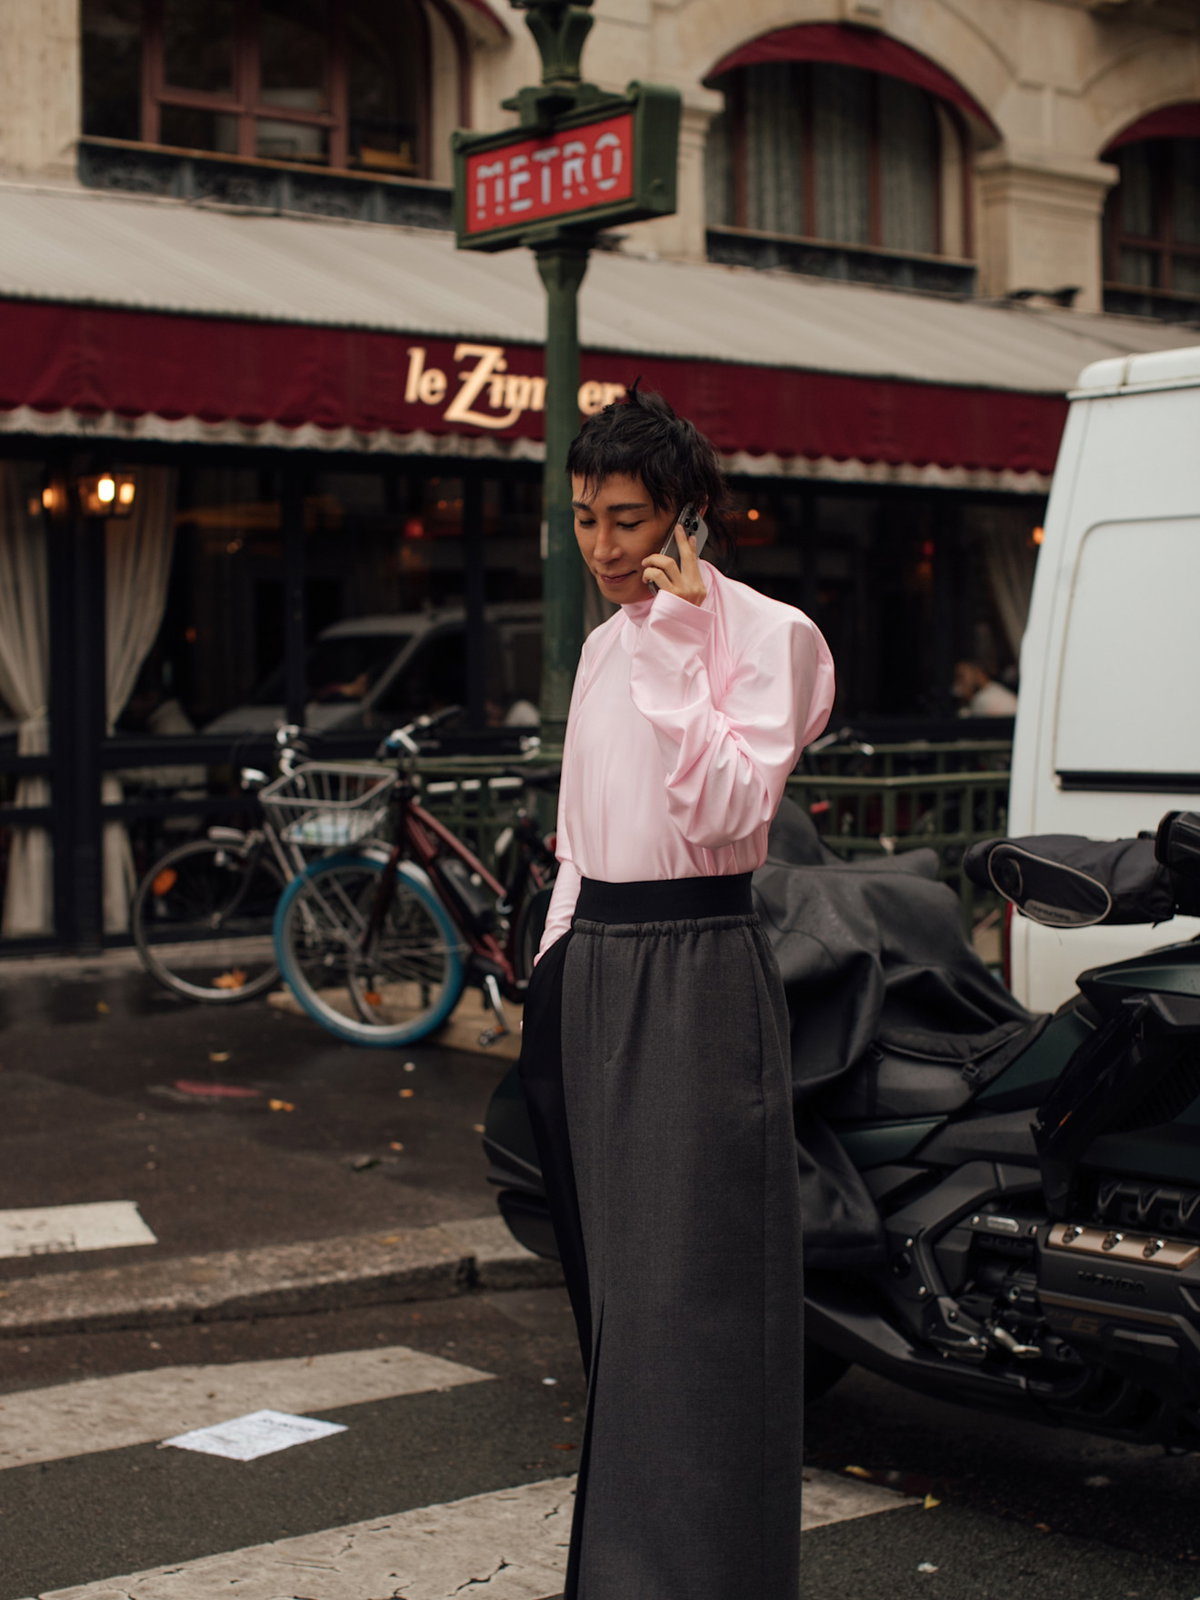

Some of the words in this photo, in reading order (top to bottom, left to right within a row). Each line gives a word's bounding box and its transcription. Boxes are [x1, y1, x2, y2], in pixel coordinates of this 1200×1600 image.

[476, 132, 622, 220] METRO
[404, 347, 447, 405] le
[443, 342, 626, 429] Zimer
